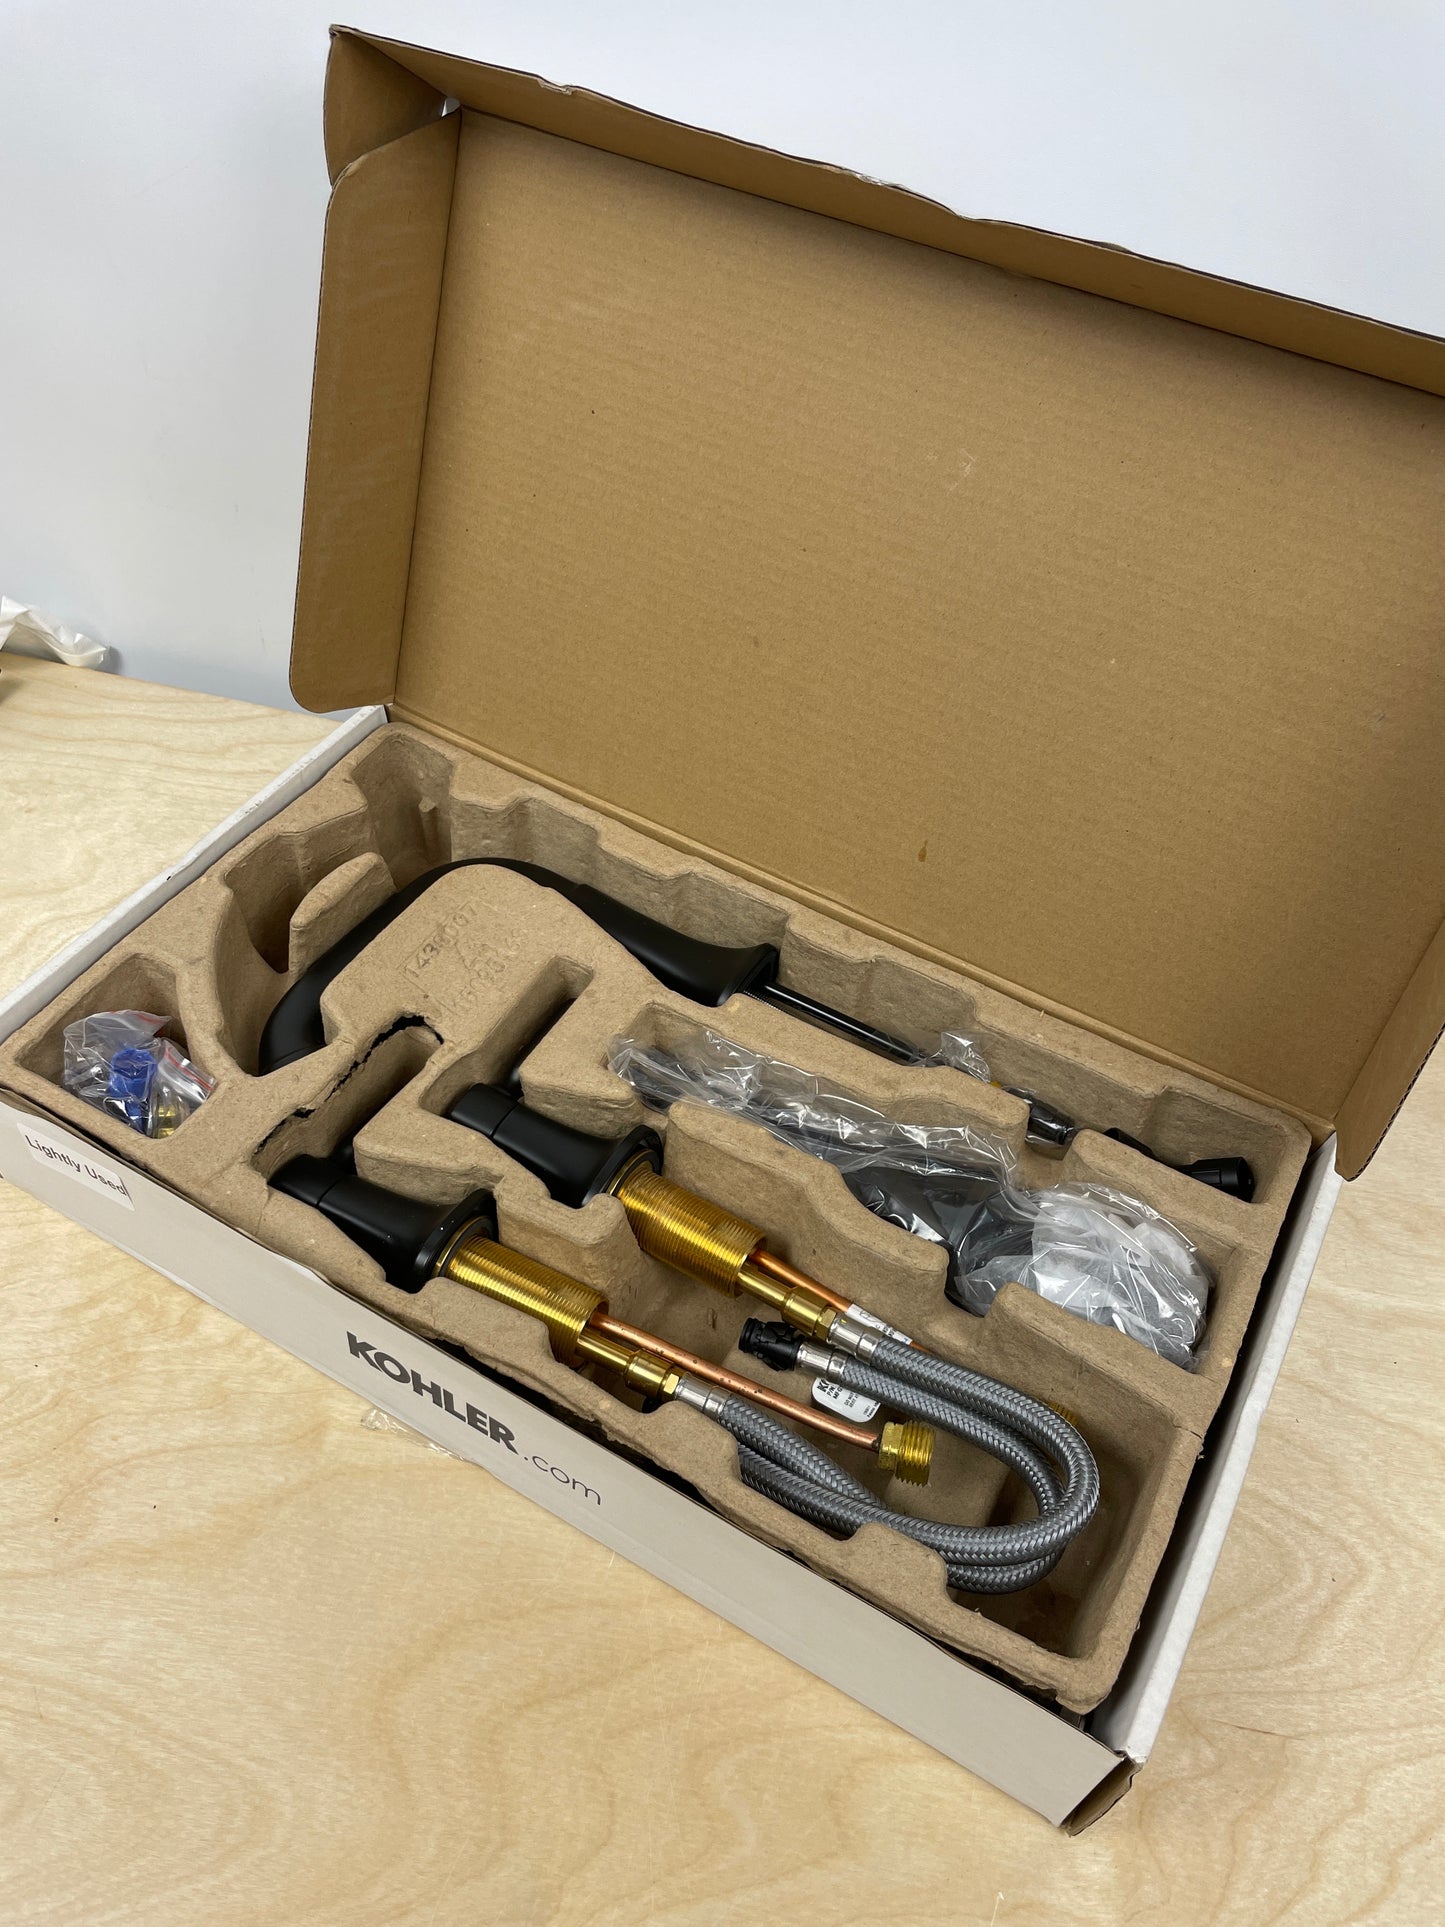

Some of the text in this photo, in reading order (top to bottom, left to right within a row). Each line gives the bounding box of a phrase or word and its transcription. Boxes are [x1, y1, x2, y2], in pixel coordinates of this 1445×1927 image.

[25, 1134, 128, 1196] Lightly Used
[346, 1331, 601, 1505] KOHLER.com
